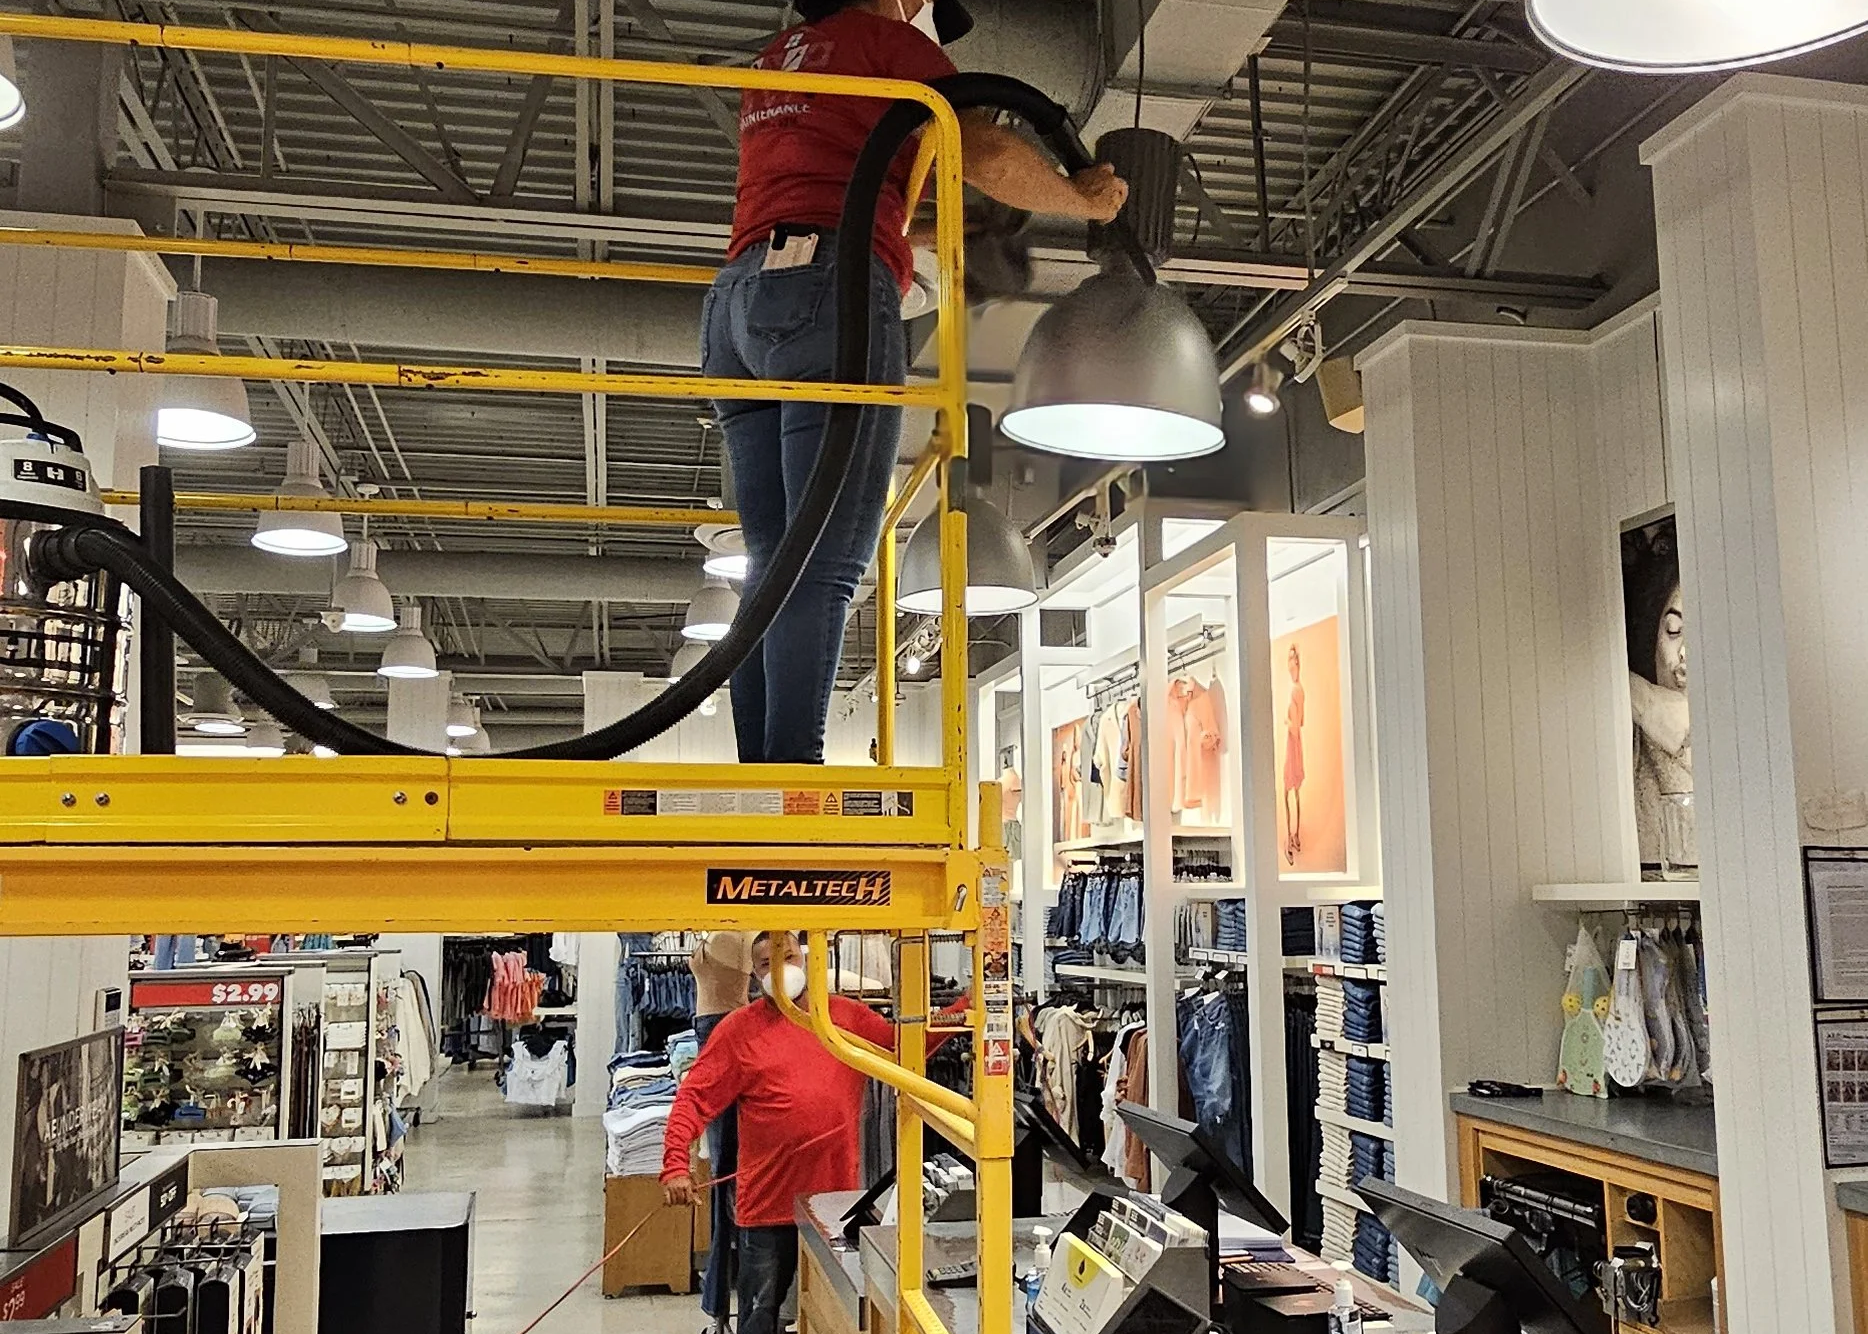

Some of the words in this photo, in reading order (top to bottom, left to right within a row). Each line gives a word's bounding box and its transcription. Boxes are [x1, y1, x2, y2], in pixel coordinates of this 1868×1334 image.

[22, 461, 33, 471] 8
[716, 876, 885, 900] METALTECH
[212, 983, 279, 1003] $2.99
